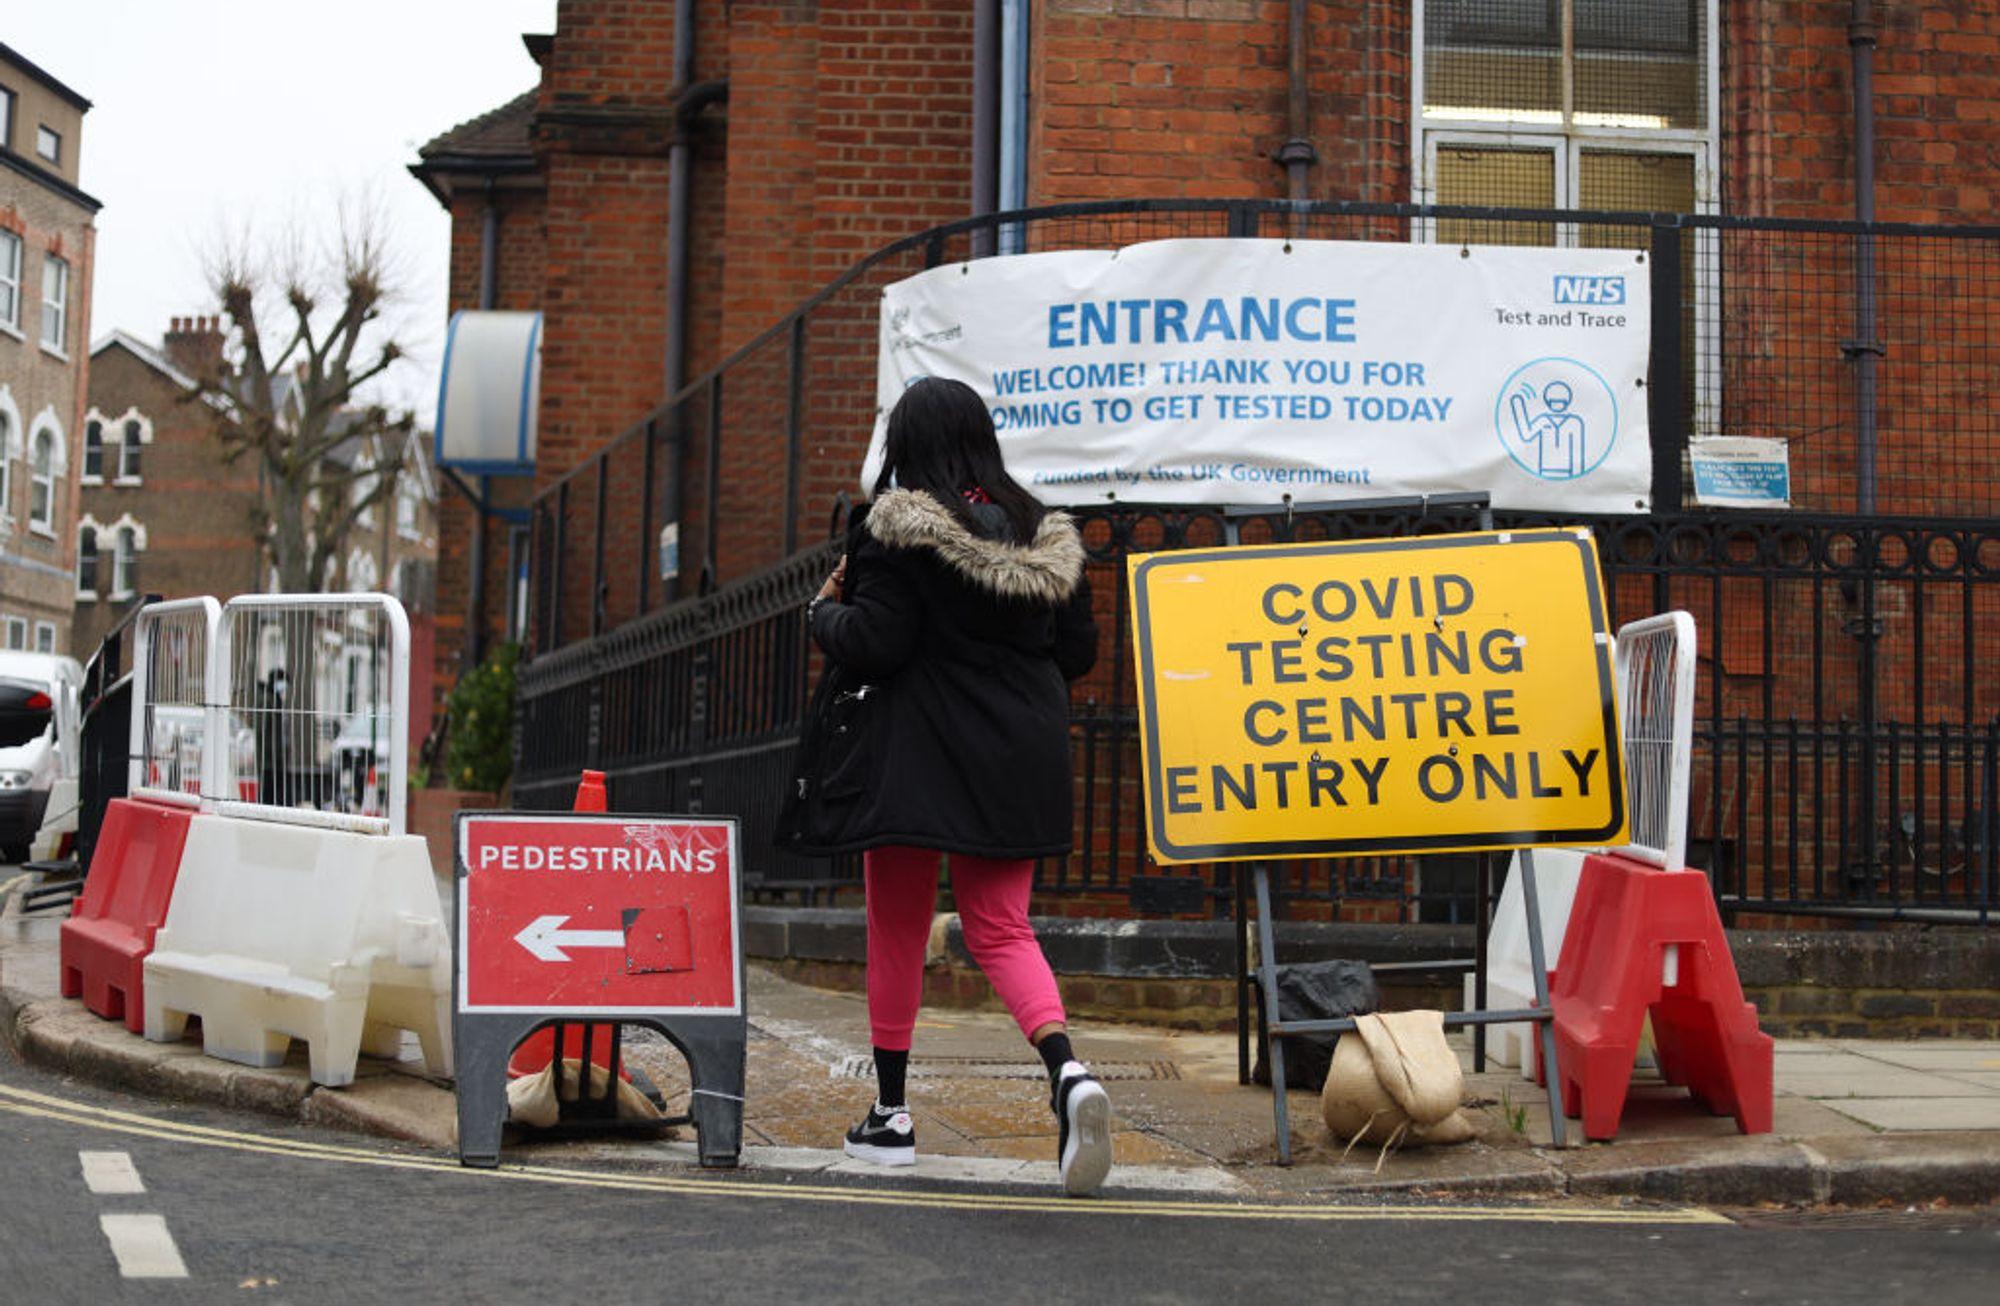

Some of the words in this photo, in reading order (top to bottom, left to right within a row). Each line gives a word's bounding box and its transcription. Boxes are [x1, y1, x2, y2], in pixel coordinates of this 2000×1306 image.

[1554, 277, 1624, 304] NHS
[1048, 297, 1356, 349] ENTRANCE
[1495, 308, 1531, 326] Test
[1537, 310, 1571, 327] and
[1577, 311, 1626, 328] Trace
[993, 362, 1146, 396] WELCOME!
[1161, 358, 1269, 385] THANK
[1284, 359, 1350, 386] YOU
[1363, 361, 1426, 387] FOR
[991, 400, 1081, 431] OMING
[1092, 398, 1132, 424] TO
[1144, 395, 1204, 421] GET
[1215, 395, 1332, 420] TESTED
[1343, 396, 1454, 422] TODAY
[1114, 468, 1141, 486] by
[1148, 464, 1185, 482] the
[1190, 464, 1223, 481] UK
[1230, 463, 1371, 485] Government
[1261, 573, 1474, 626] COVID
[1226, 627, 1524, 686] TESTING
[1243, 688, 1521, 747] CENTRE
[1166, 756, 1391, 815] ENTRY
[1417, 748, 1600, 804] ONLY
[479, 845, 717, 874] PEDESTRIANS
